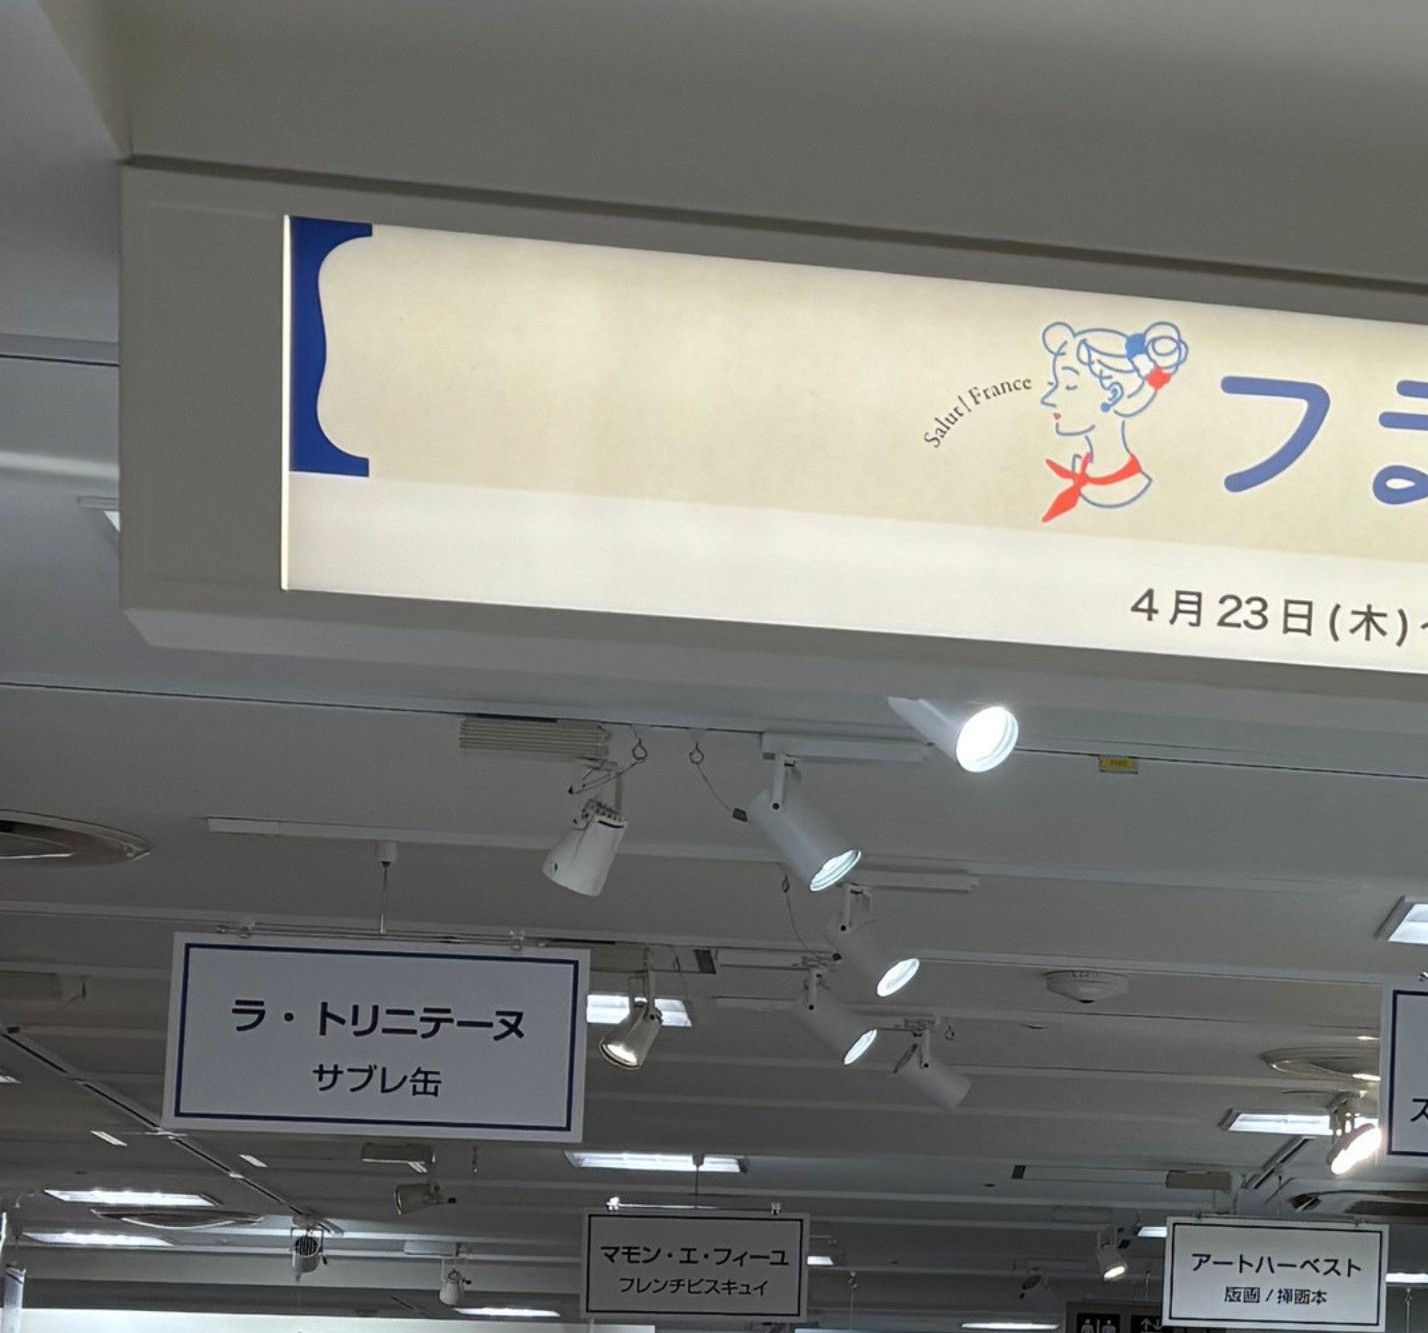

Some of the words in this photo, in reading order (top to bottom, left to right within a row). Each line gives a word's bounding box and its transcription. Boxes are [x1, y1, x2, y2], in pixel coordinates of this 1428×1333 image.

[968, 378, 1032, 405] France
[231, 998, 526, 1042] ラ・トリニテーヌ
[312, 1064, 442, 1098] サブレ缶
[600, 1244, 788, 1267] マモン・エ・フィーユ
[1191, 1251, 1362, 1278] アートハーベスト
[619, 1276, 768, 1297] フレンチビスキュイ
